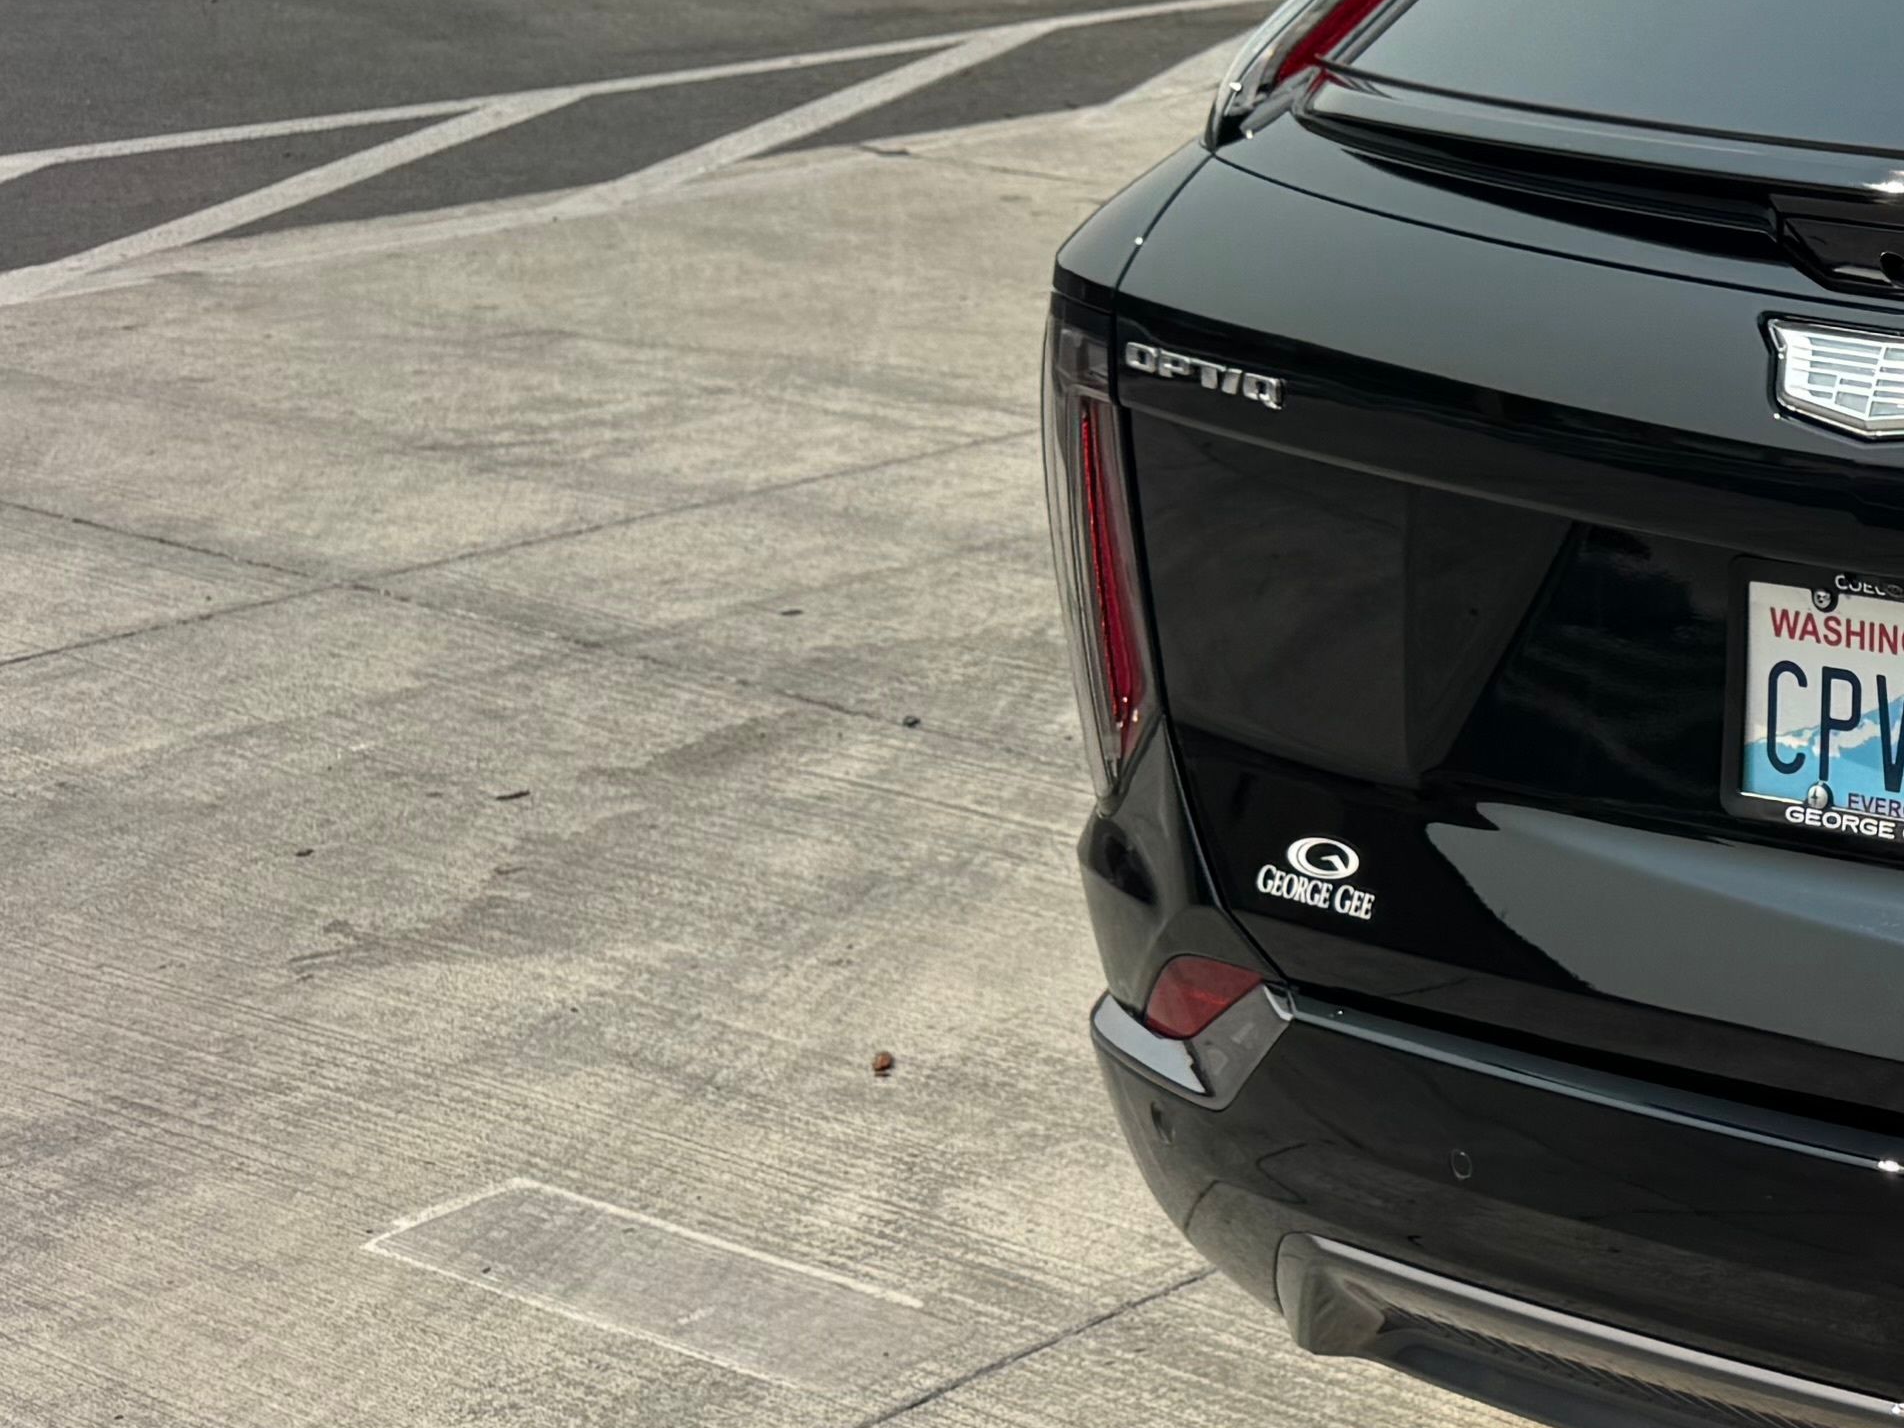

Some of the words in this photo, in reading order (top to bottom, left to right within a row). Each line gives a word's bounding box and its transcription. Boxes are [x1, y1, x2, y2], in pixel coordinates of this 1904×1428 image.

[1125, 341, 1286, 410] OPTIQ
[1785, 805, 1896, 840] GEORGE
[1256, 864, 1333, 909] GEORGE
[1334, 884, 1376, 920] GEE
